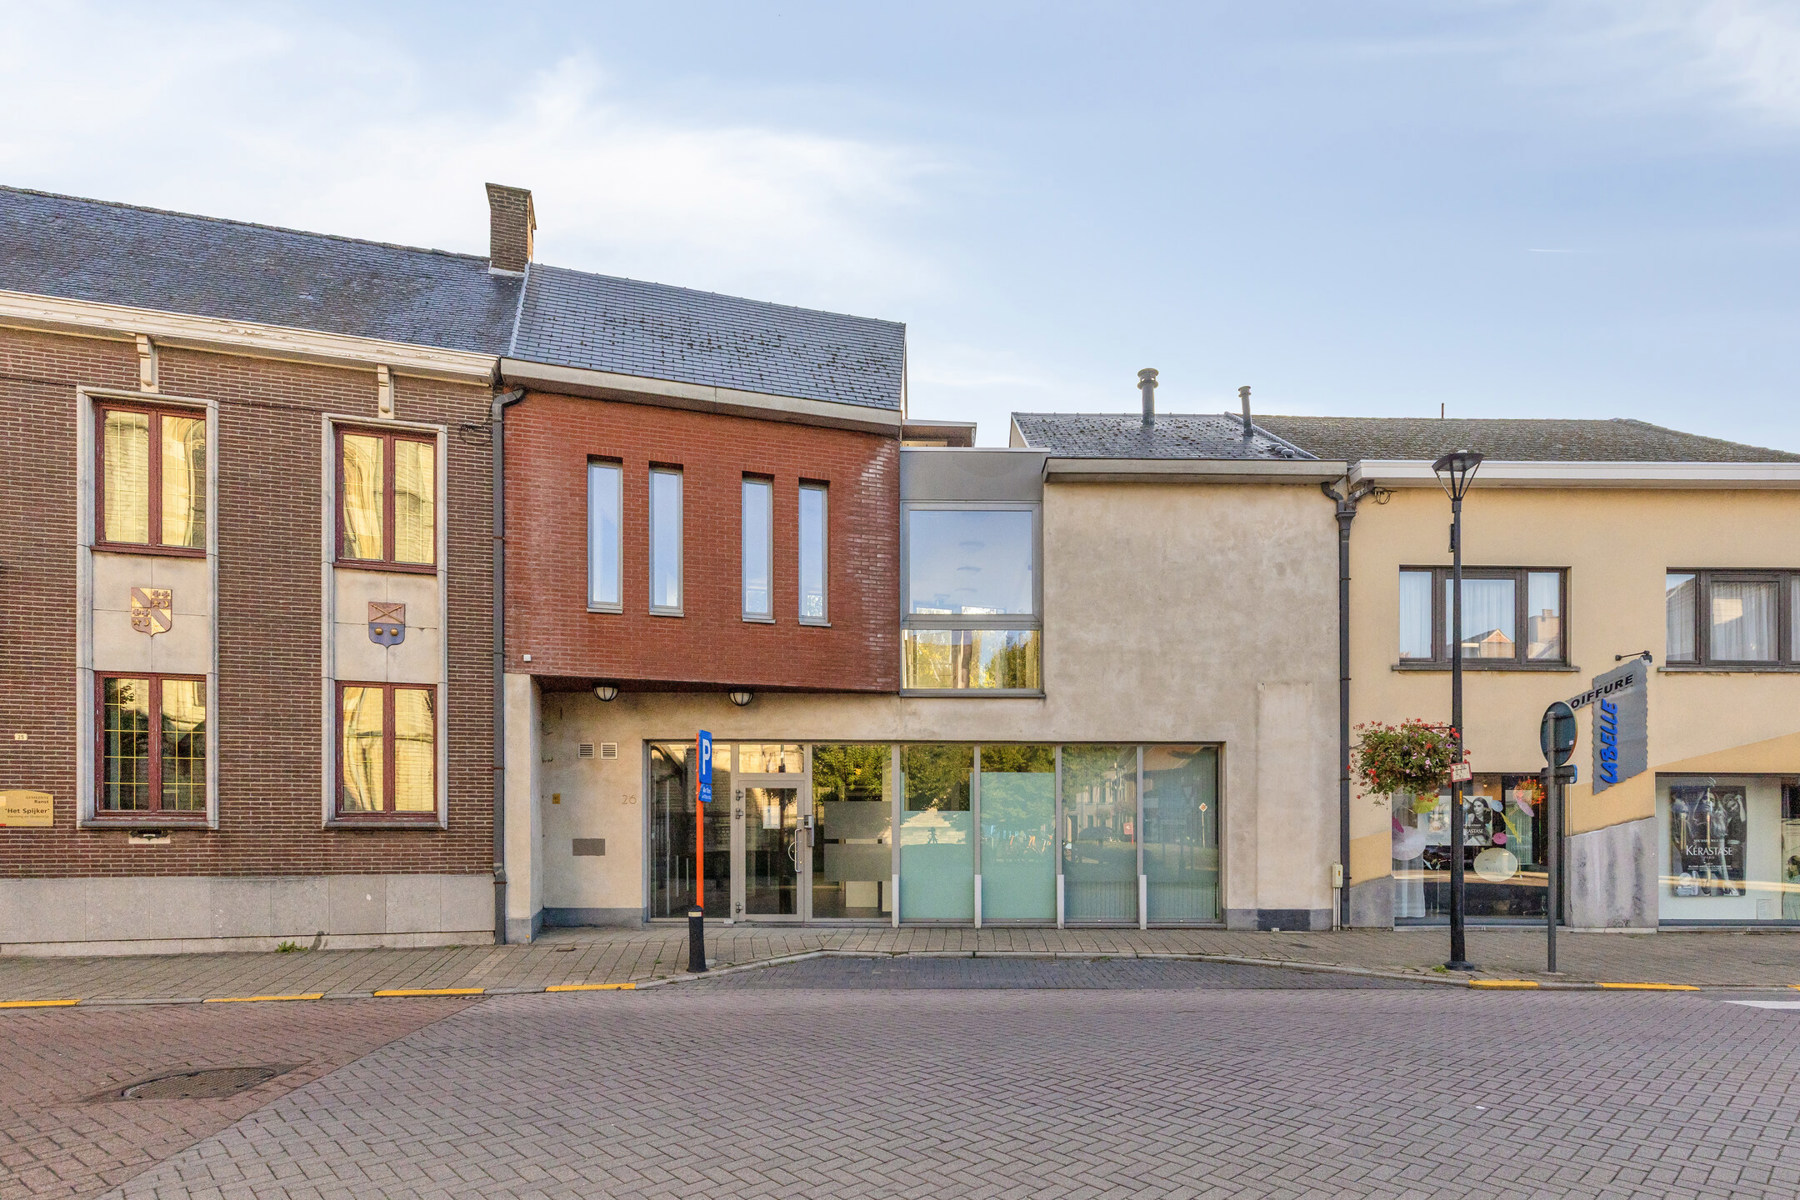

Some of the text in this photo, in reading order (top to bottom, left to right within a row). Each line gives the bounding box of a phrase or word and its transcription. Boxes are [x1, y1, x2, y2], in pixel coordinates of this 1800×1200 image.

[1570, 674, 1634, 710] OIFFURE
[702, 738, 711, 775] P
[1600, 697, 1618, 784] LABELLE
[621, 794, 637, 805] 26
